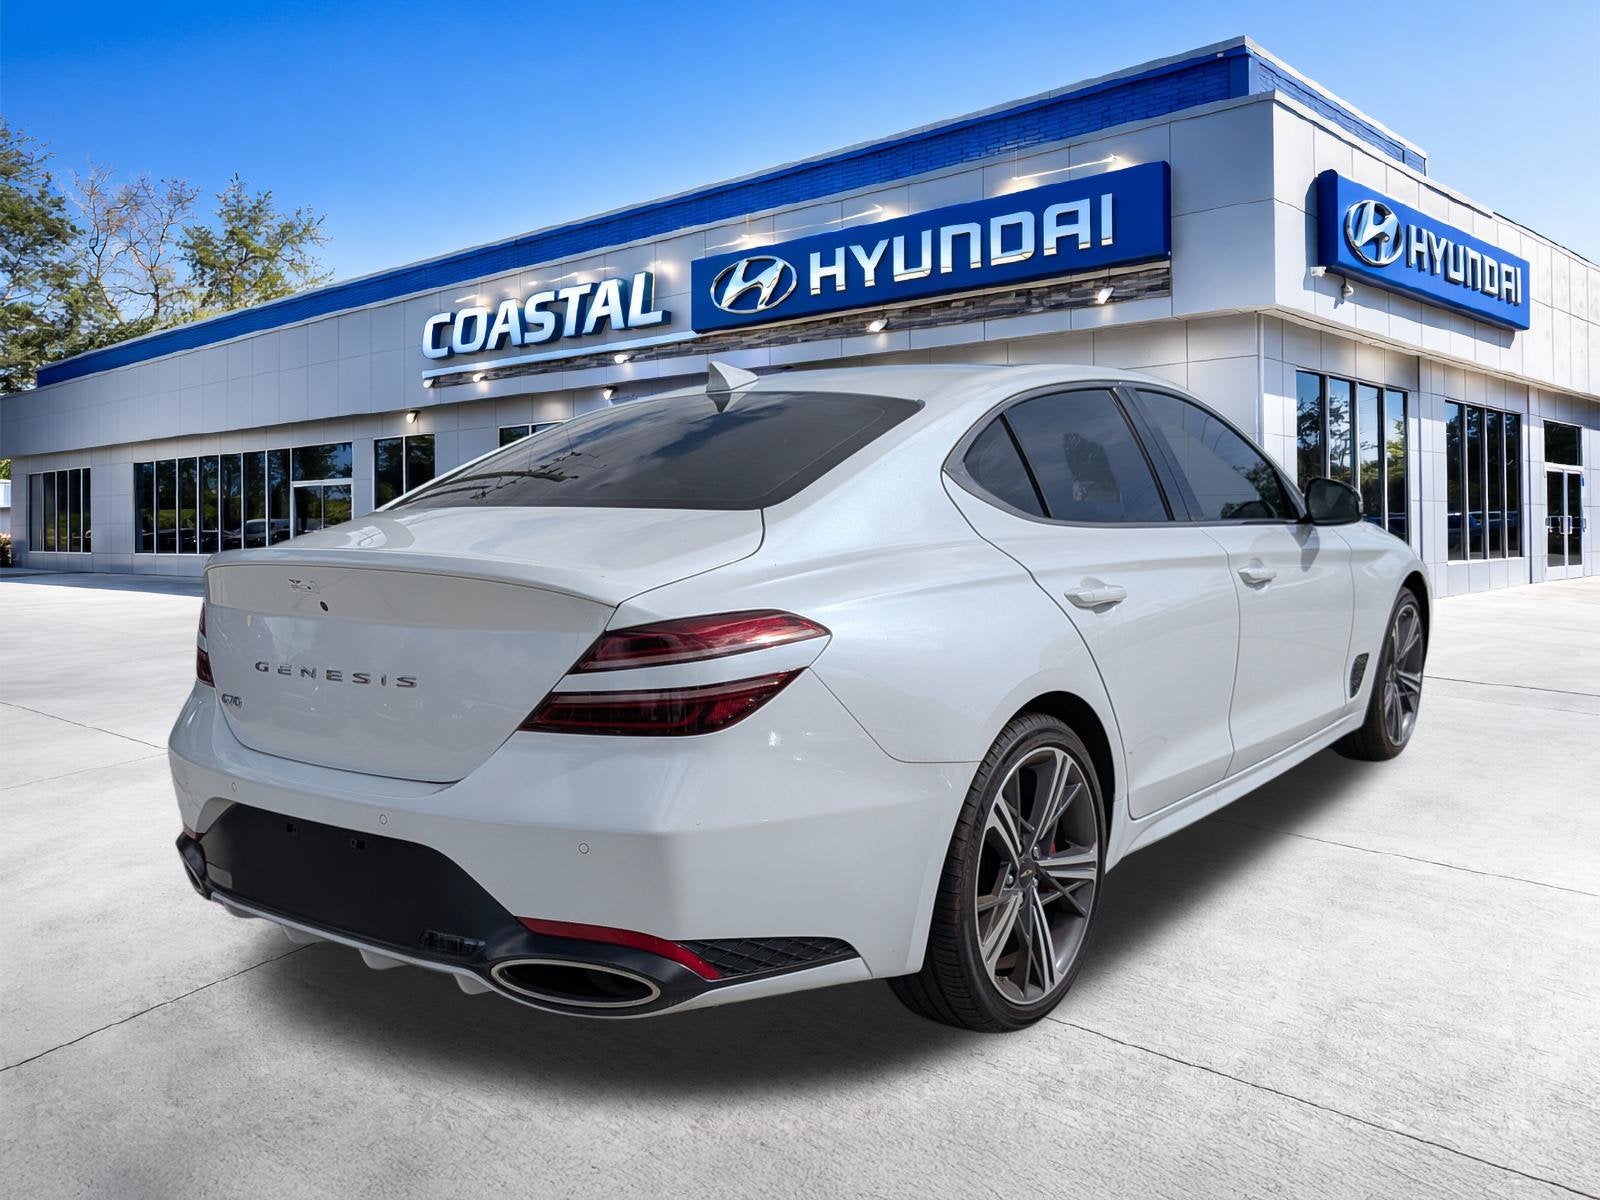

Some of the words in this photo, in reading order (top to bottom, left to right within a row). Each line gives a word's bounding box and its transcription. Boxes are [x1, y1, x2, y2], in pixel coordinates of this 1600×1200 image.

[809, 193, 1113, 295] HYUNDAI
[1406, 224, 1522, 306] HYUNDAI
[421, 271, 670, 360] COASTAL
[221, 693, 243, 708] G70
[254, 661, 418, 688] GENESIS
